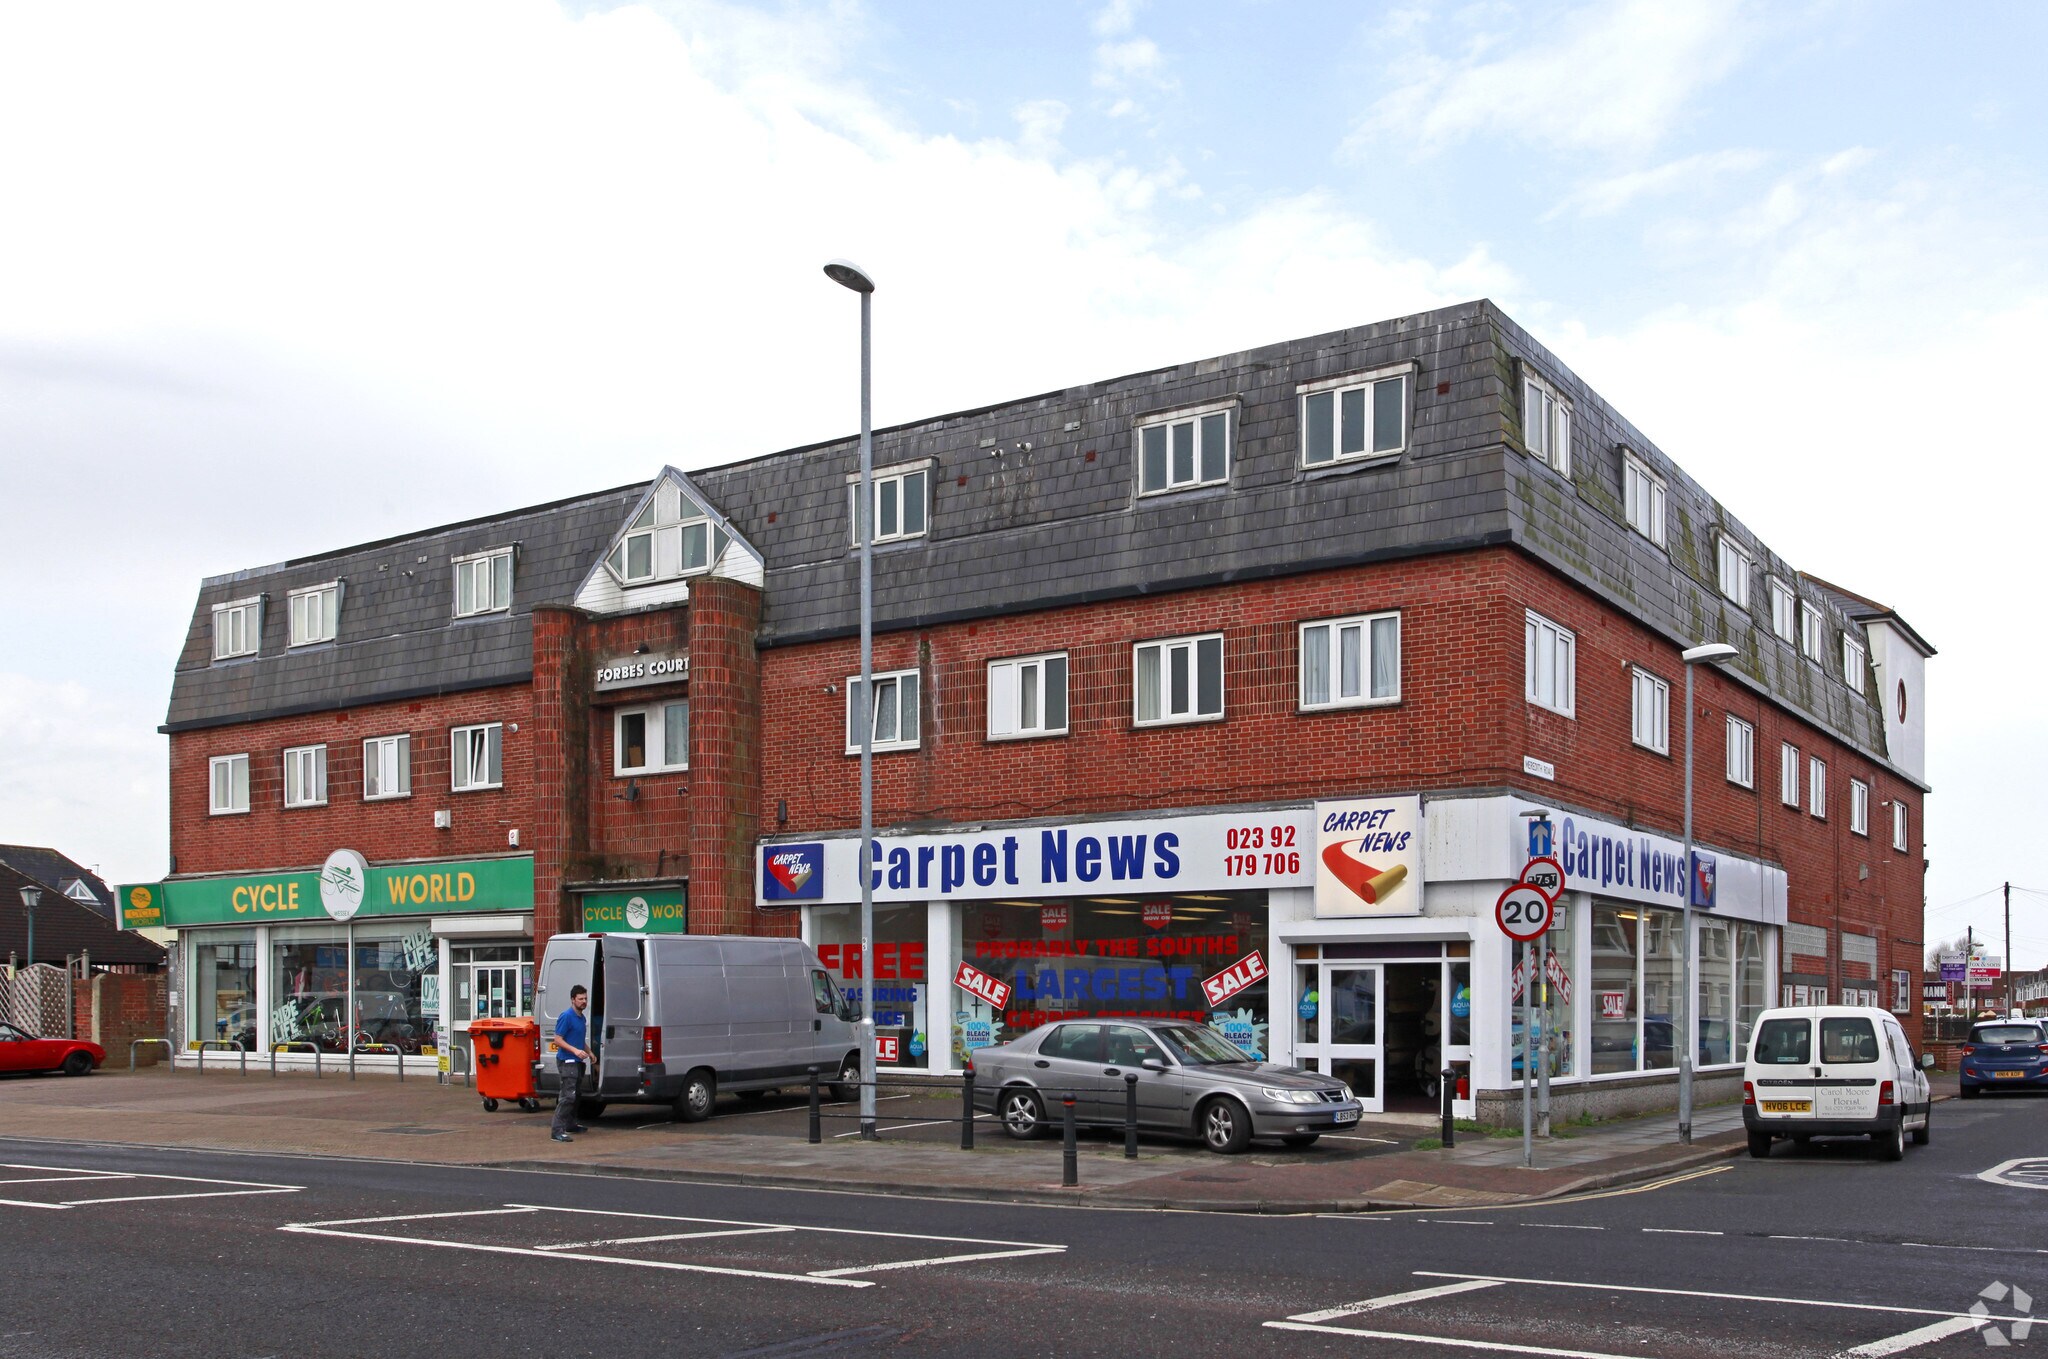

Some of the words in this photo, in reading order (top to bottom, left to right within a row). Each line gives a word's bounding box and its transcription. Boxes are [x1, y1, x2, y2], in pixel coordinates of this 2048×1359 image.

[597, 663, 644, 682] FORBES
[649, 656, 689, 675] COURT
[1323, 808, 1396, 833] CARPET
[1226, 827, 1264, 850] 023
[1270, 825, 1296, 848] 92
[1359, 831, 1412, 854] NEWS
[773, 853, 804, 866] CARPET
[788, 863, 812, 875] NEWS
[859, 836, 1019, 894] Carpet
[1042, 829, 1180, 884] News
[1224, 854, 1257, 877] 179
[1263, 852, 1300, 875] 706
[1562, 816, 1634, 888] Carpet
[1640, 838, 1685, 898] News
[232, 882, 299, 913] CYCLE
[388, 872, 475, 905] WORLD
[129, 909, 155, 918] CYCLE
[585, 906, 622, 921] CYCLE
[652, 904, 684, 919] WOR
[1042, 907, 1067, 918] SALE
[1144, 904, 1171, 915] SALE
[1504, 900, 1545, 924] 20
[401, 927, 434, 954] RIDE
[976, 939, 1089, 959] PROBABLY
[1096, 937, 1139, 957] THE
[1147, 935, 1239, 957] SOUTHS
[405, 941, 434, 971] LIFE
[818, 942, 925, 979] FREE
[959, 967, 1006, 1004] SALE
[1016, 967, 1193, 1001] LARGEST
[1208, 955, 1265, 1002] SALE
[1512, 954, 1537, 999] SAE
[1547, 956, 1572, 1003] SALE
[271, 998, 300, 1026] RIDE
[422, 1001, 439, 1009] FINANC
[1299, 1004, 1316, 1012] AQUA
[1452, 1001, 1470, 1009] AQUA
[1603, 996, 1623, 1015] SALE
[273, 1017, 300, 1043] LIFE
[967, 1022, 990, 1031] 100%
[1225, 1022, 1253, 1032] 100%
[875, 1039, 896, 1058] LE
[1821, 1088, 1843, 1096] Carol
[1845, 1088, 1870, 1096] Moore
[1765, 1102, 1788, 1111] HV06
[1791, 1102, 1807, 1111] LCE
